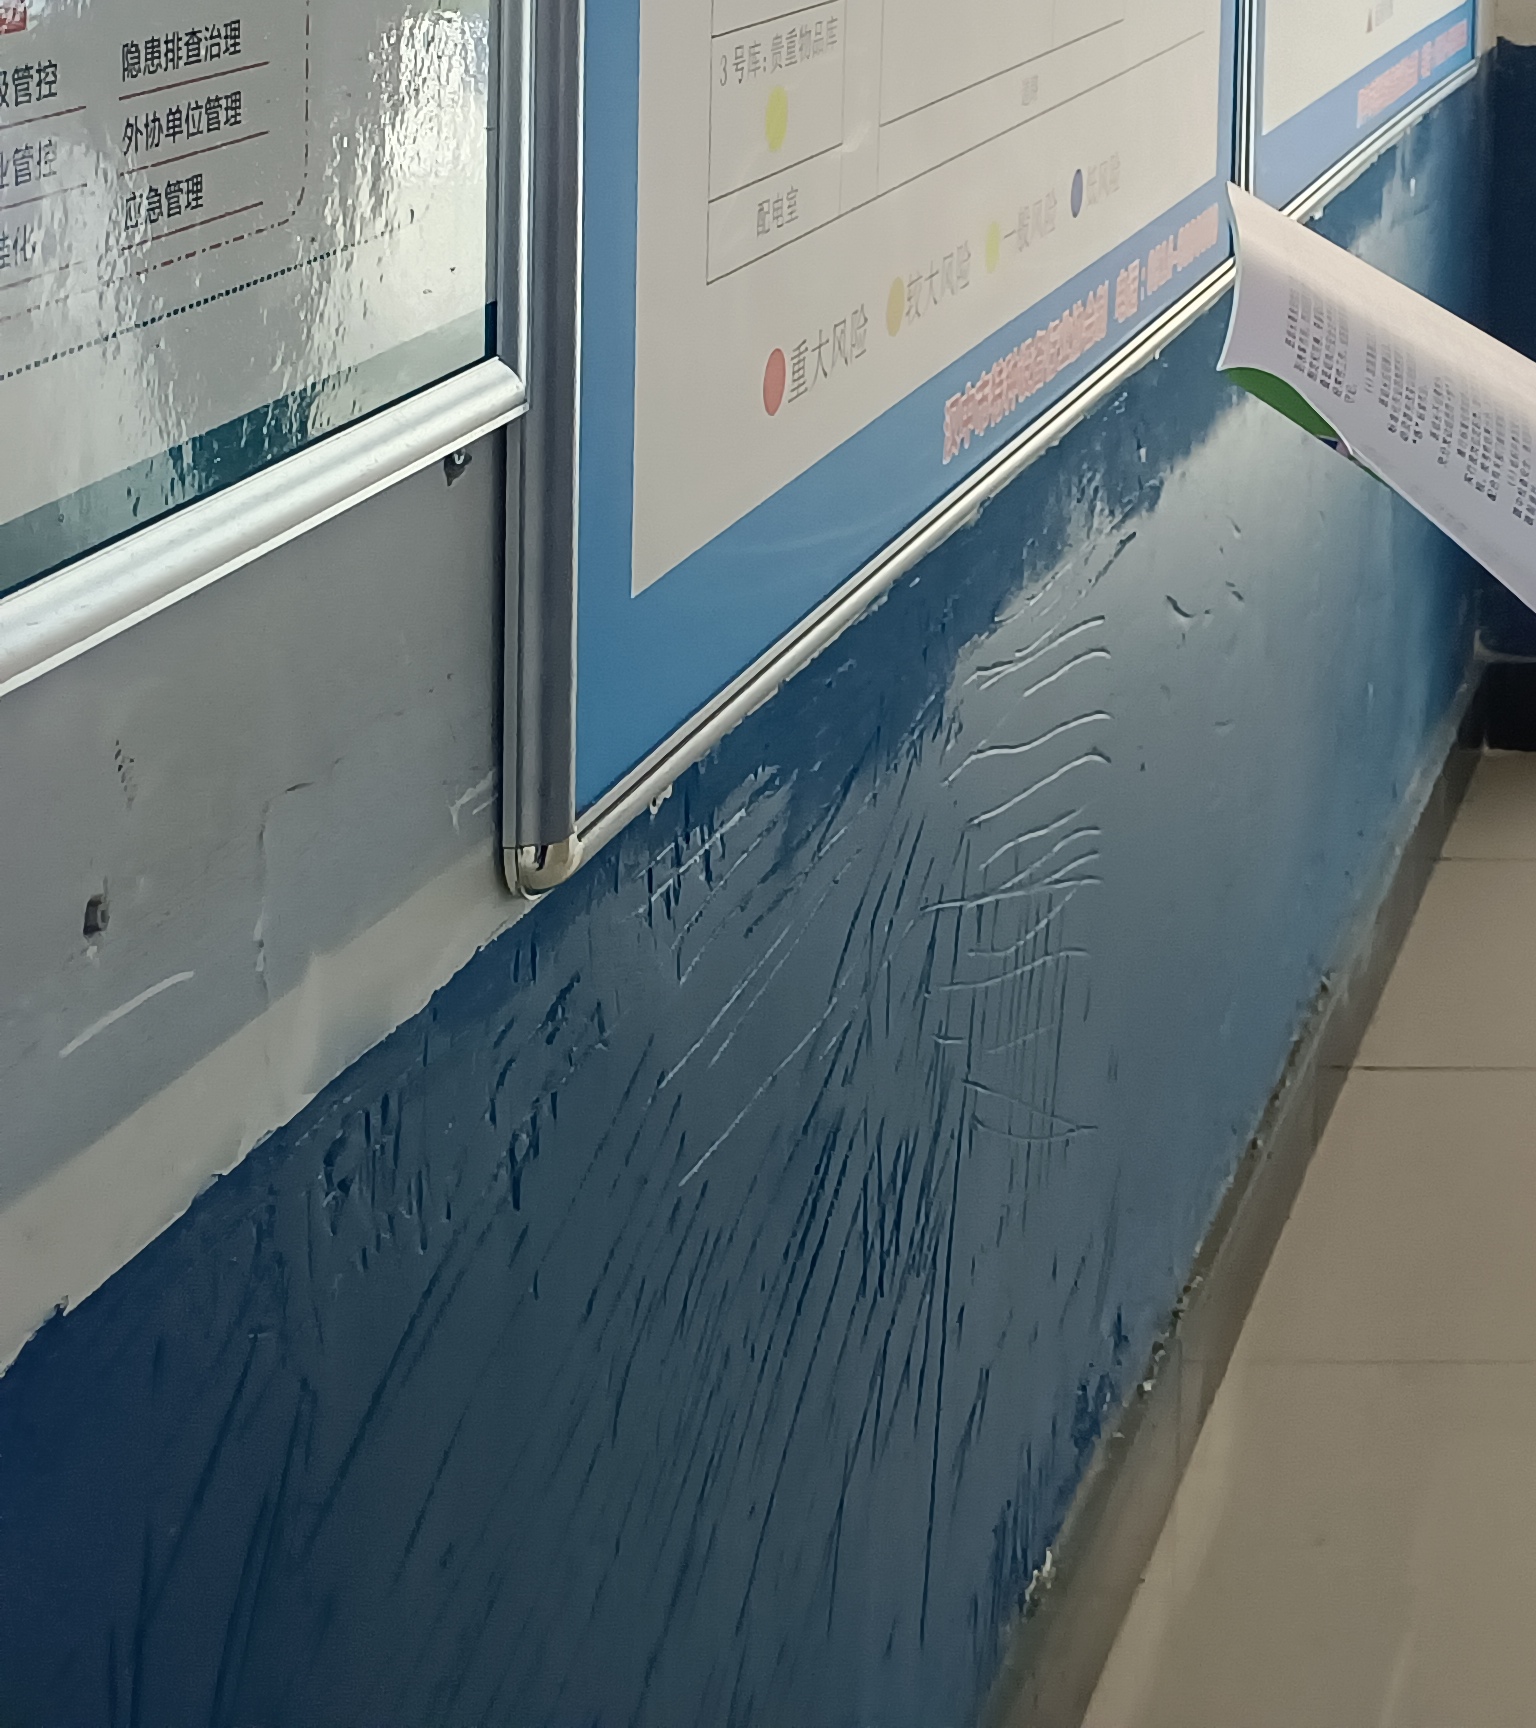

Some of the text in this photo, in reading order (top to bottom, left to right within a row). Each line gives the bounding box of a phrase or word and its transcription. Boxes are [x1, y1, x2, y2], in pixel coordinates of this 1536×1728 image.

[121, 18, 242, 83] 隐患排查治理
[121, 90, 243, 157] 外协单位管理
[123, 173, 204, 232] 应急管理
[787, 303, 869, 406] 重大风险
